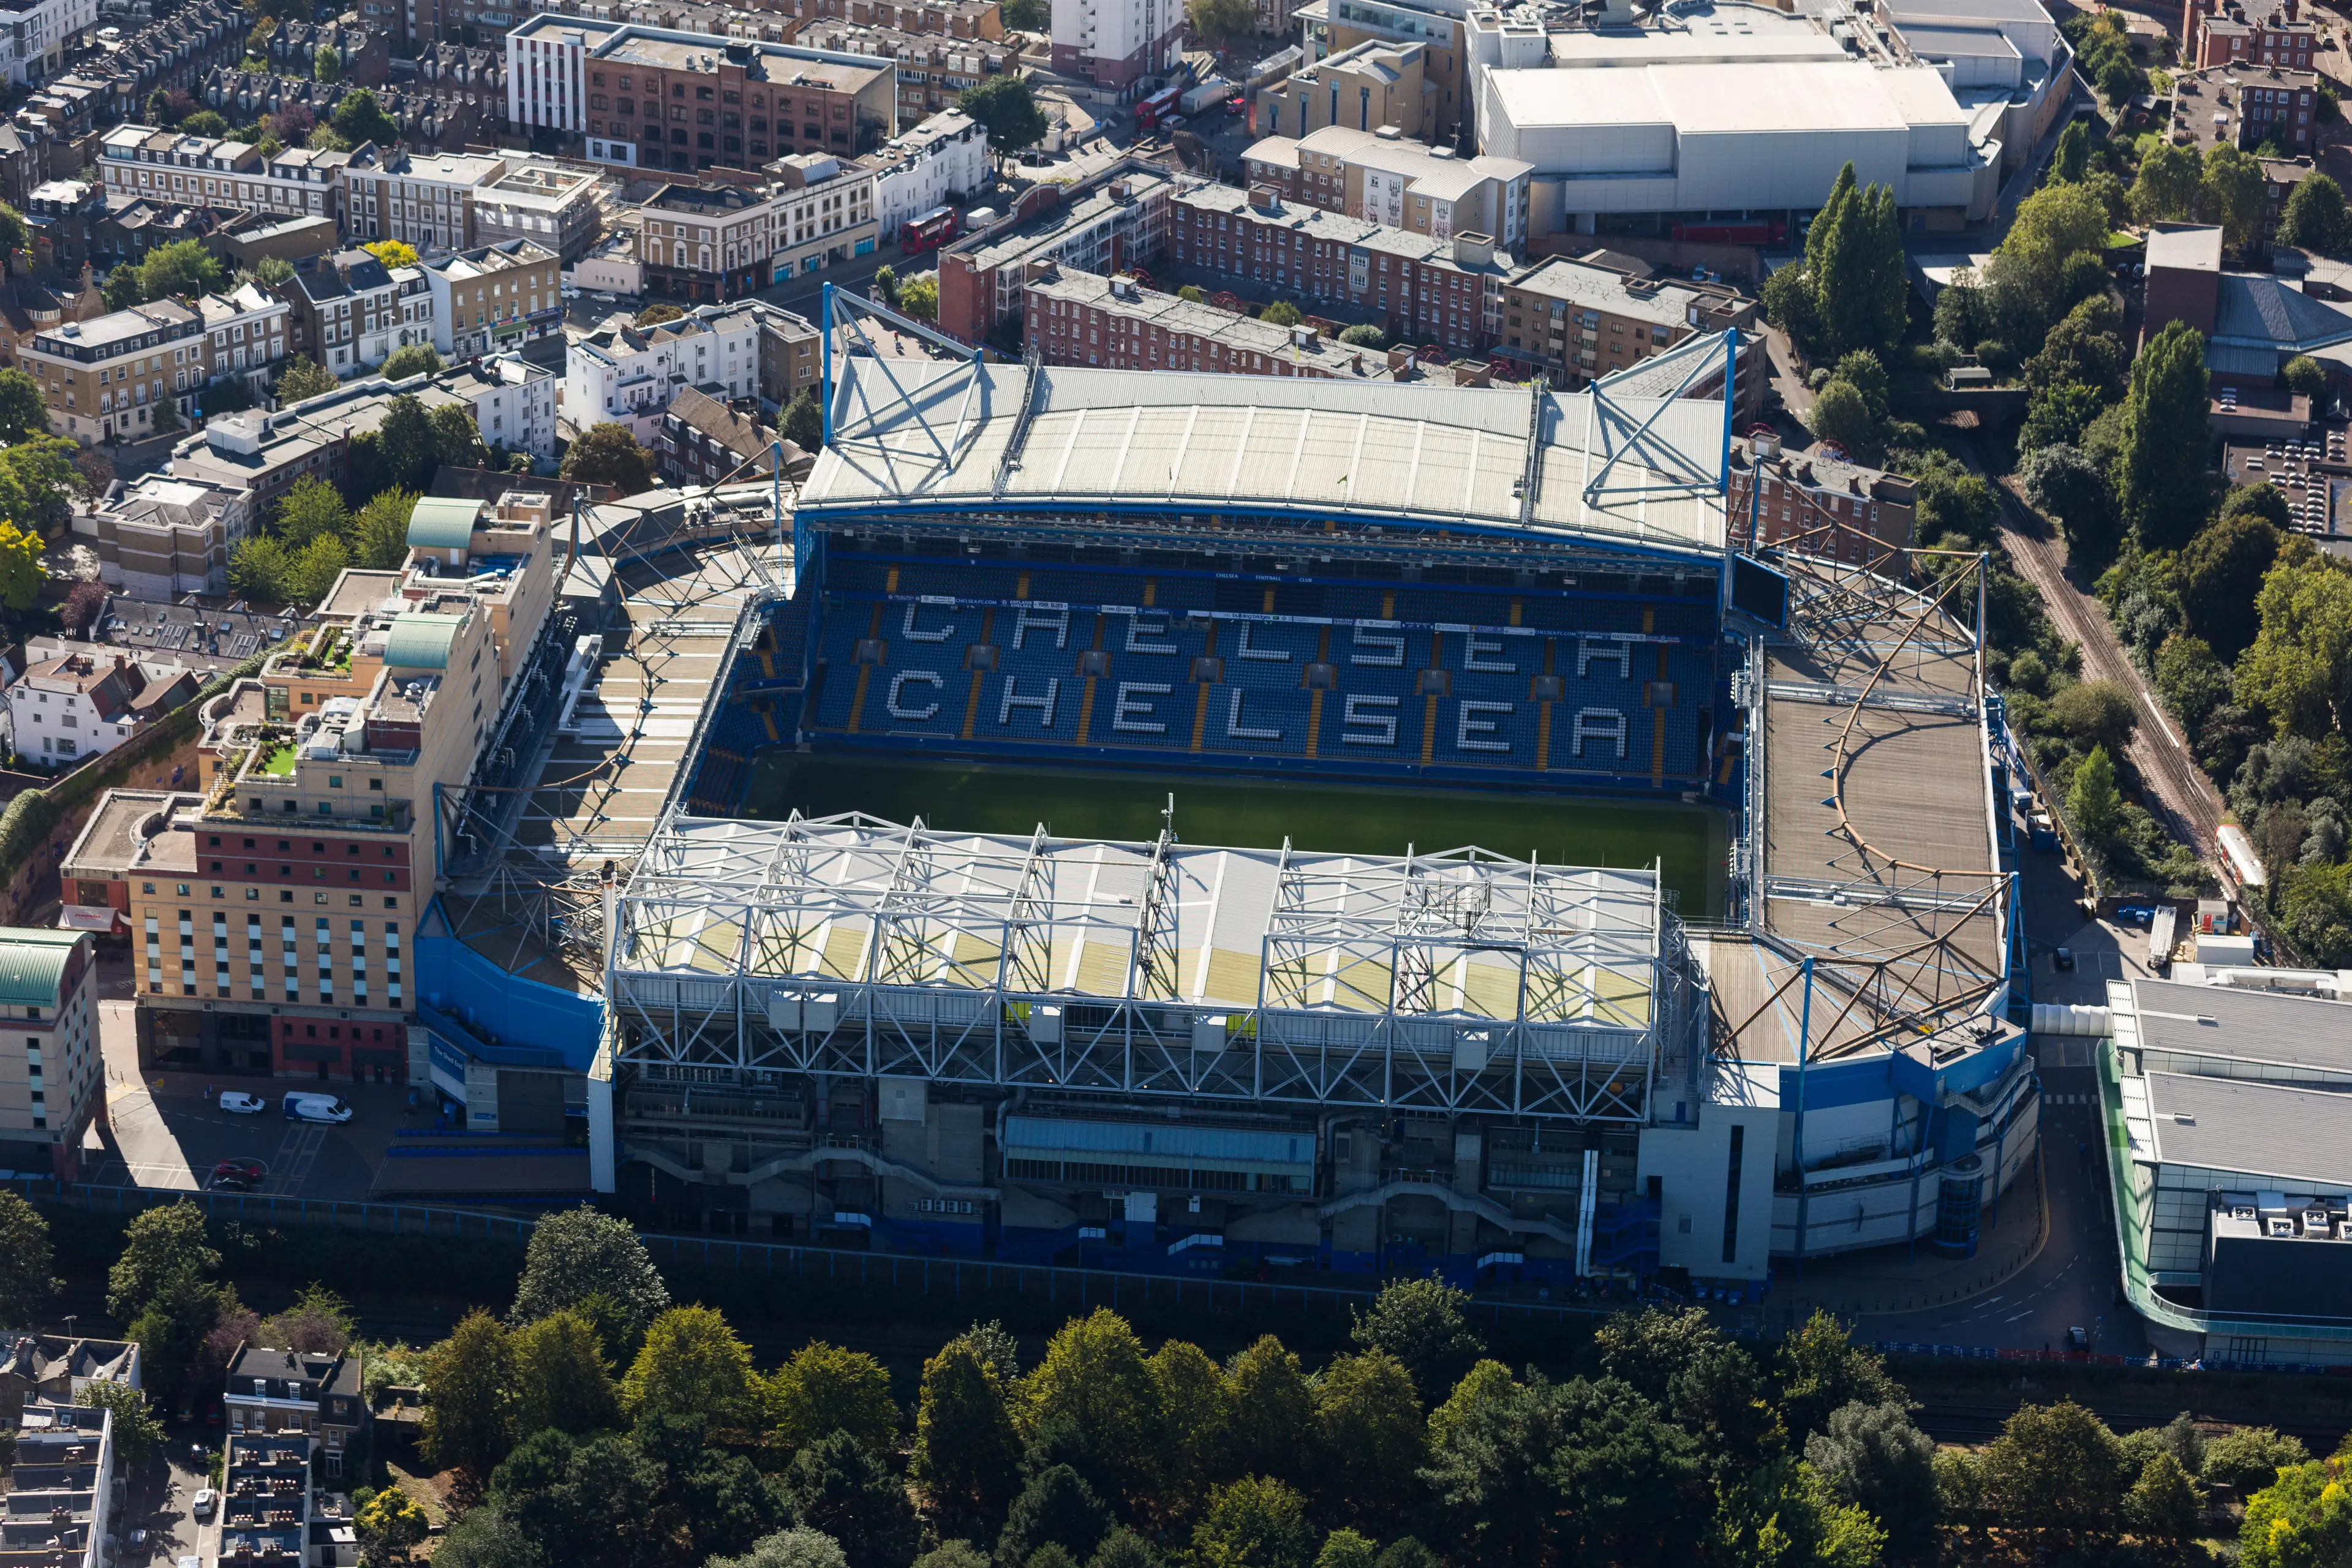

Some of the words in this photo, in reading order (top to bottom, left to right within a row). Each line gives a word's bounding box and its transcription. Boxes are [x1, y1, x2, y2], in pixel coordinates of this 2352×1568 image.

[887, 669, 1627, 758] CHELSEA
[434, 1046, 443, 1055] The
[443, 1052, 454, 1064] Shed
[454, 1060, 464, 1070] End
